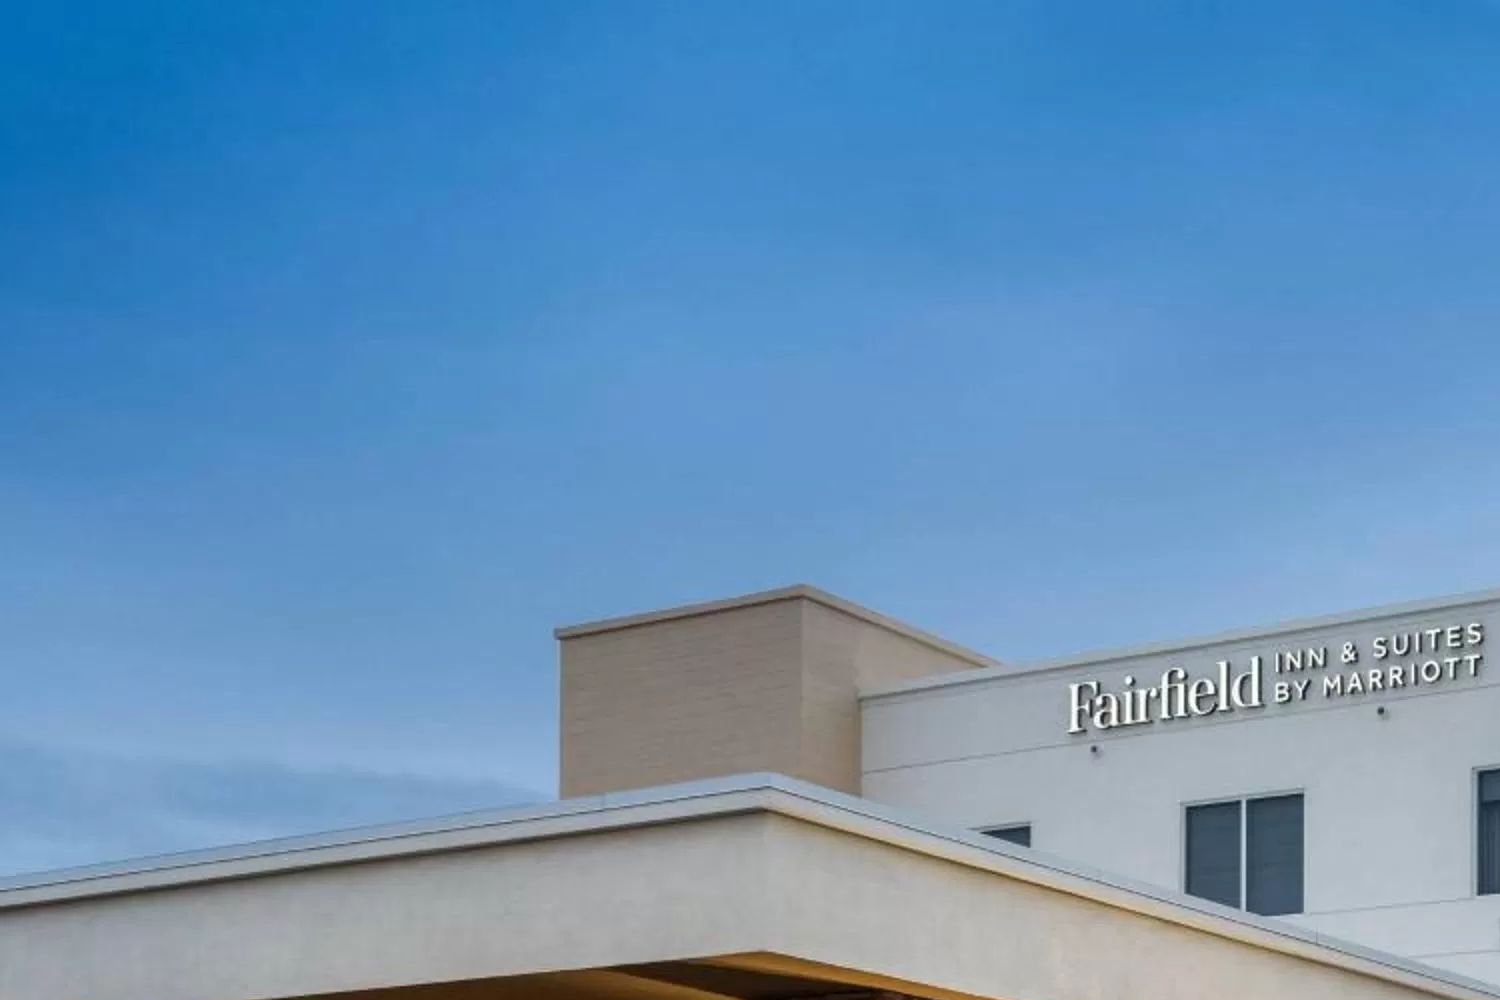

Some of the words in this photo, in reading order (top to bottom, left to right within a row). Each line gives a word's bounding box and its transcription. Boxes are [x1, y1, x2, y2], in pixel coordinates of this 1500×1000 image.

[1275, 642, 1327, 674] INN
[1341, 641, 1360, 664] &
[1372, 622, 1486, 661] SUITES
[1066, 655, 1265, 735] Fairfield
[1274, 679, 1312, 704] BY
[1323, 654, 1485, 698] MARRIOTT
